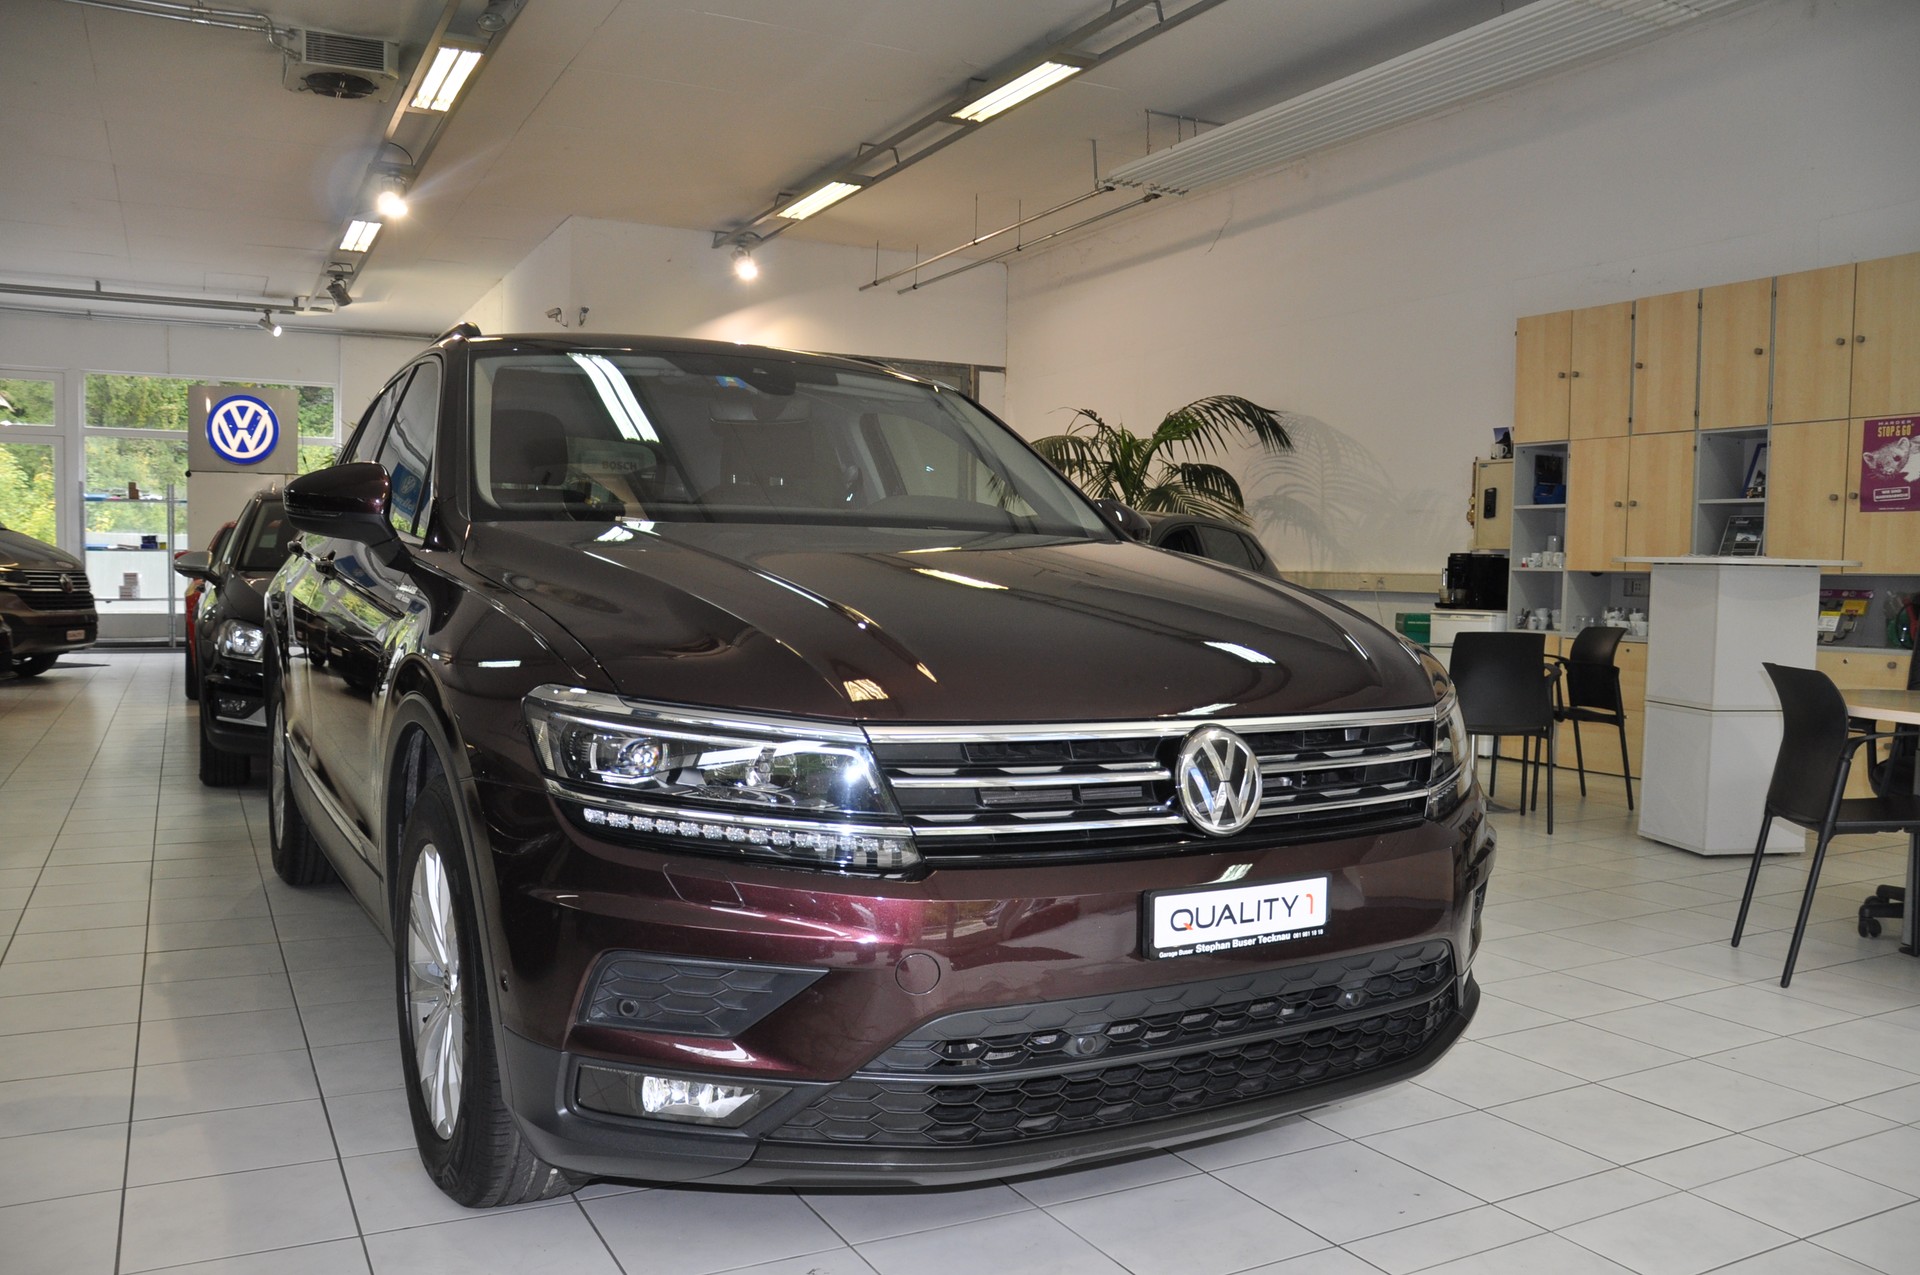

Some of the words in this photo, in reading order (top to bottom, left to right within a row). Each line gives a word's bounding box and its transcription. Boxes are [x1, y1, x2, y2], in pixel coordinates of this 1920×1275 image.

[210, 399, 274, 459] VW
[1877, 426, 1895, 437] STOP
[1895, 425, 1901, 436] &
[1901, 424, 1912, 436] GO
[602, 461, 637, 471] BOSCH
[1179, 727, 1261, 834] VW
[1170, 895, 1299, 931] QUALITY
[1306, 893, 1313, 914] 1
[1195, 941, 1231, 953] Stephan
[1232, 937, 1257, 948] Buser
[1257, 932, 1291, 944] Tecknau
